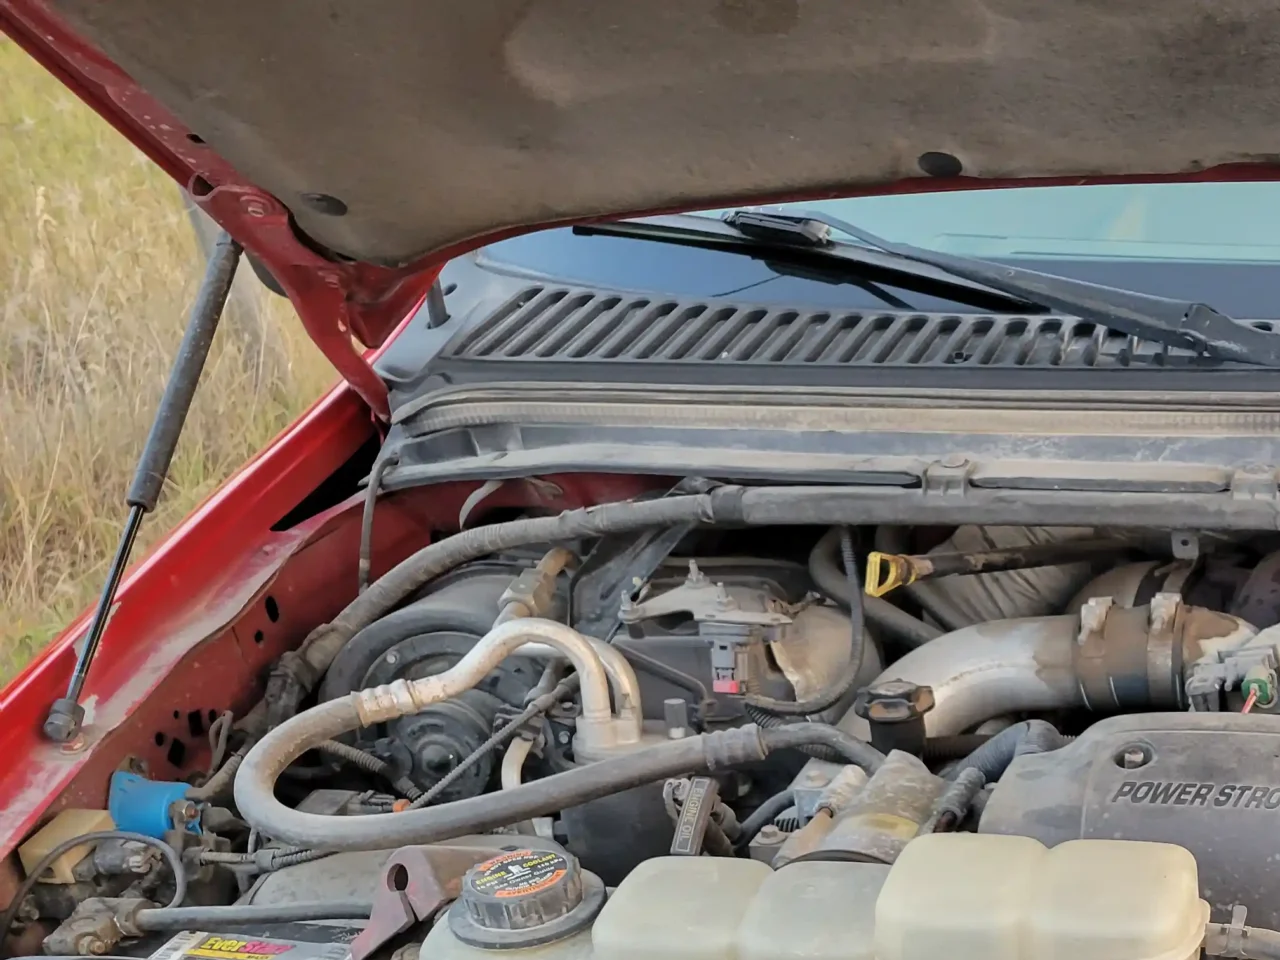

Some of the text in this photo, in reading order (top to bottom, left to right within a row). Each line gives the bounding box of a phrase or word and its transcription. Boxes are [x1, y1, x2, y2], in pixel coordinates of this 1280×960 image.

[1111, 781, 1214, 805] POWER
[679, 788, 704, 841] ENGINE OIL
[522, 853, 556, 868] COOLANT
[202, 936, 296, 955] EverStart
